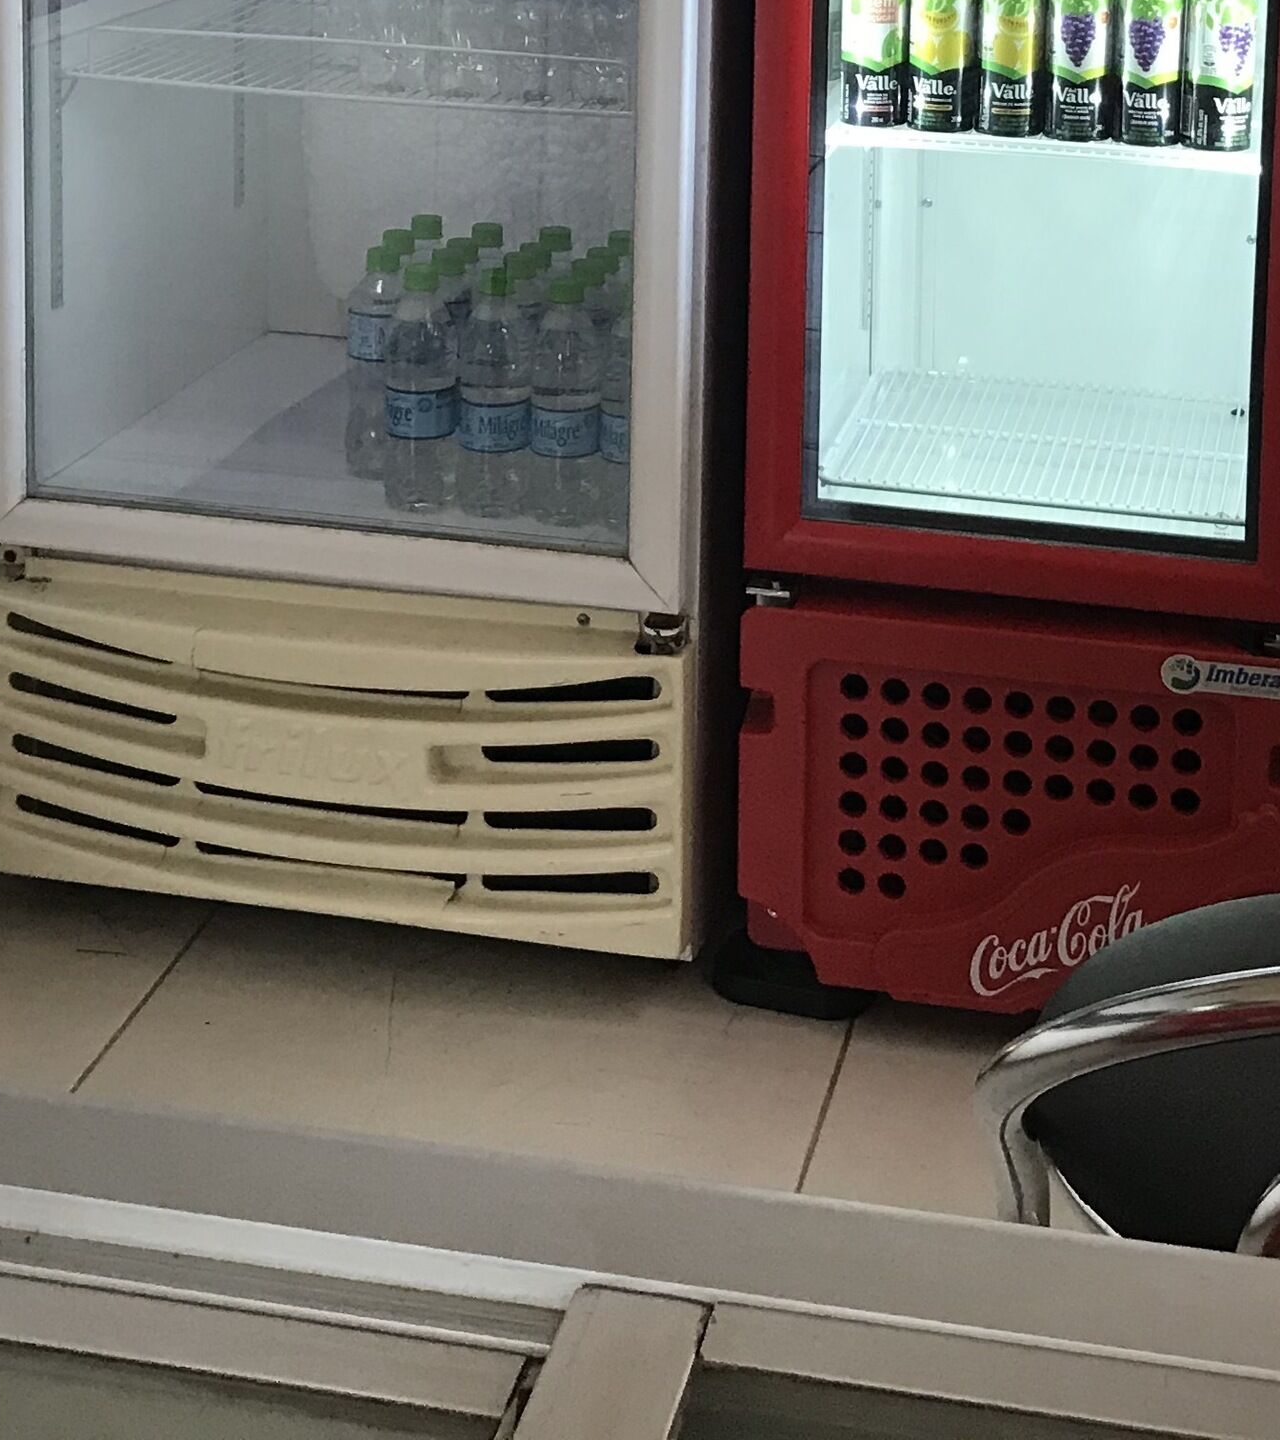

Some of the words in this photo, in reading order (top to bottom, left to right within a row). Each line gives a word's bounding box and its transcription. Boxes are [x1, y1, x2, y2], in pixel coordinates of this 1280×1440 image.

[855, 73, 898, 91] Valle
[913, 75, 954, 96] Valle
[969, 881, 1148, 997] Coca-Cola
